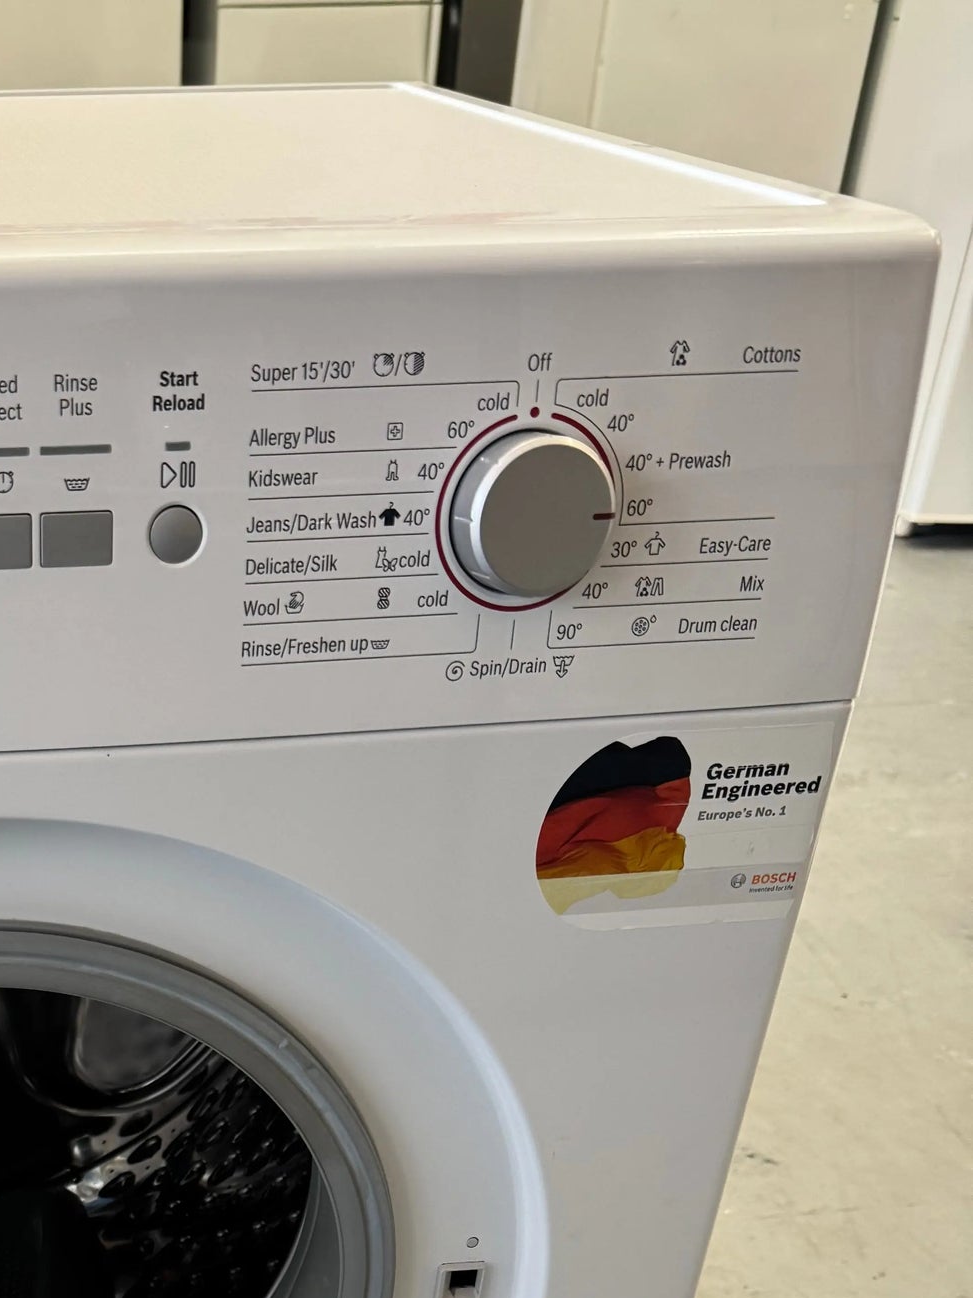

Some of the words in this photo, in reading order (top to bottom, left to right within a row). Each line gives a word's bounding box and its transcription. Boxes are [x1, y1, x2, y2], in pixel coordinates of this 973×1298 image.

[528, 353, 552, 372] Off
[743, 346, 801, 364] Cottons
[54, 374, 98, 392] Rinse
[160, 370, 198, 387] Start
[251, 363, 297, 385] Super
[152, 393, 205, 412] Reload
[477, 392, 510, 411] cold
[577, 388, 609, 407] cold
[60, 398, 93, 417] Plus
[447, 420, 475, 439] 60°
[607, 414, 635, 432] 40°
[249, 428, 300, 449] Allergy
[304, 426, 336, 444] Plus
[669, 450, 731, 470] Prewash
[248, 469, 318, 487] Kidswear
[417, 462, 445, 480] 40°
[626, 498, 653, 516] 60°
[246, 513, 332, 535] Jeans/Dark
[336, 511, 377, 529] Wash
[403, 508, 431, 526] 40°
[610, 541, 637, 558] 30°
[699, 535, 771, 556] Easy-Care
[245, 554, 338, 575] Delicate/Silk
[398, 550, 431, 568] cold
[582, 582, 608, 600] 40°
[739, 575, 765, 592] Mix
[243, 598, 280, 617] Wool
[417, 590, 449, 608] cold
[556, 623, 583, 641] 90°
[678, 618, 716, 634] Drum
[719, 616, 757, 632] clean
[241, 636, 346, 658] Rinse/Freshen
[350, 638, 369, 654] up
[469, 657, 547, 679] Spin/Drain
[707, 763, 790, 780] German
[701, 776, 822, 802] Engineered
[698, 807, 752, 821] Europe's
[755, 807, 776, 818] No.
[779, 806, 787, 816] 1
[751, 872, 796, 885] BOSCH
